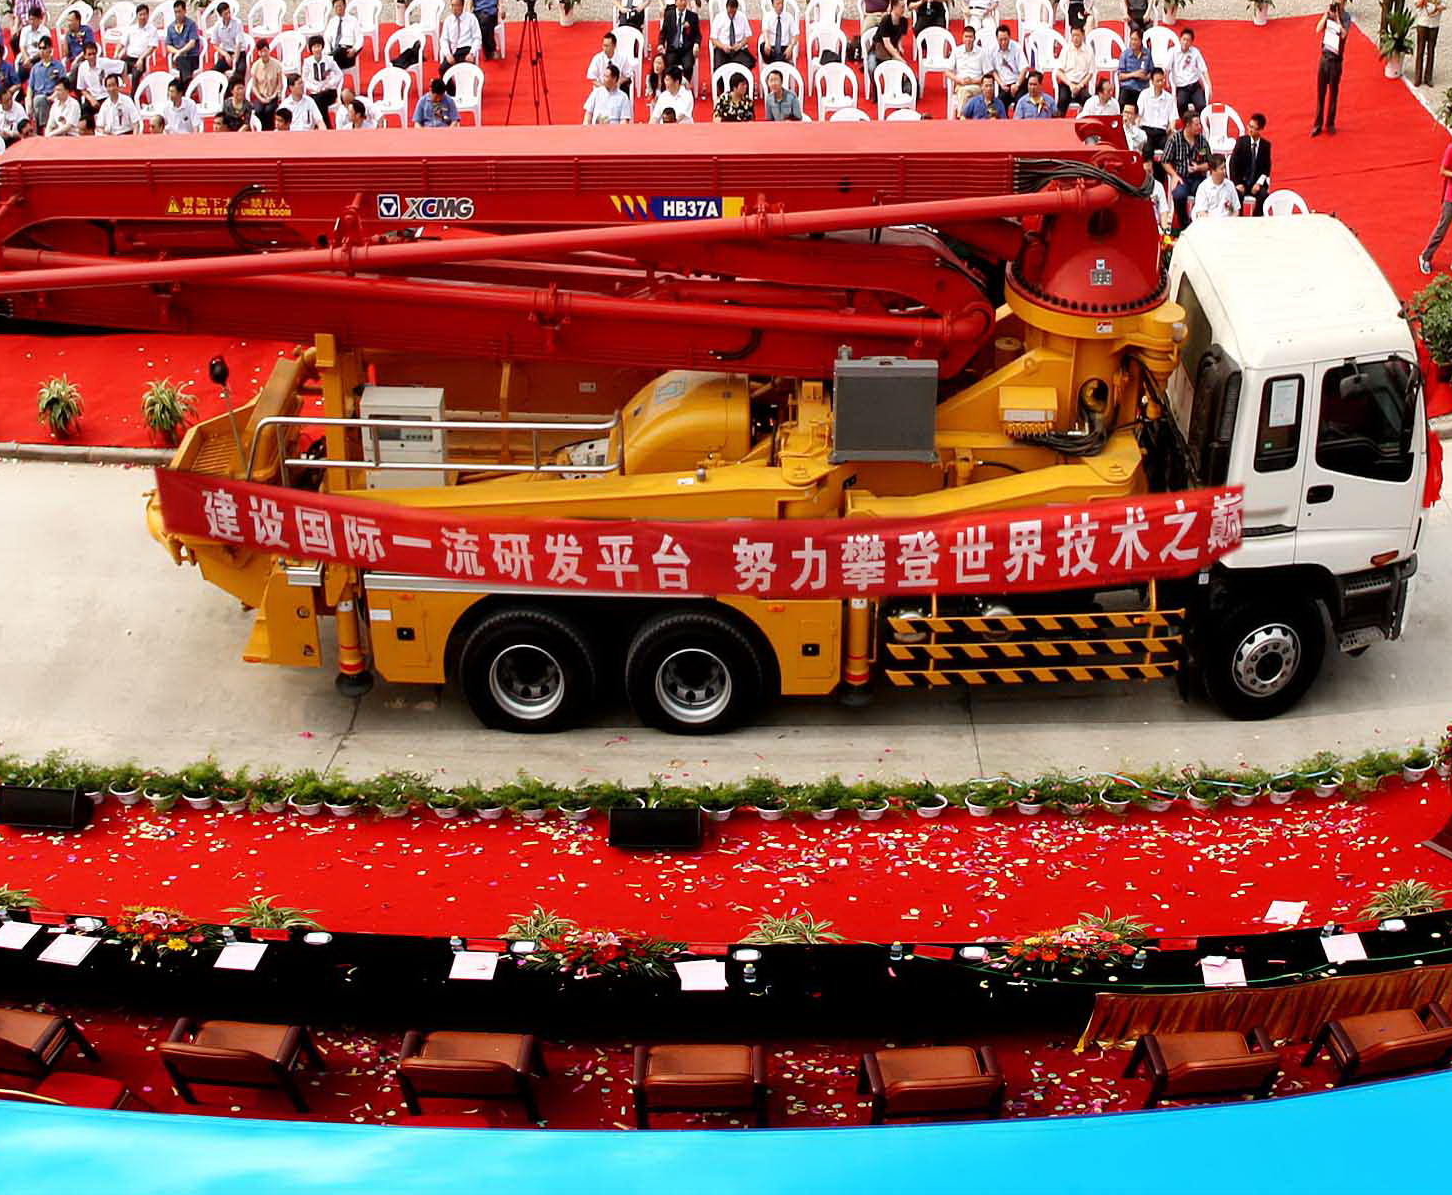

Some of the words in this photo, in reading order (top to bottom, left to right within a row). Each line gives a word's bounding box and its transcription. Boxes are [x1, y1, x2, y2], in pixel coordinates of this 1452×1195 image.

[402, 197, 475, 220] XCMG
[662, 200, 719, 218] HB37A
[200, 488, 692, 592] 建设国际一流研发平台
